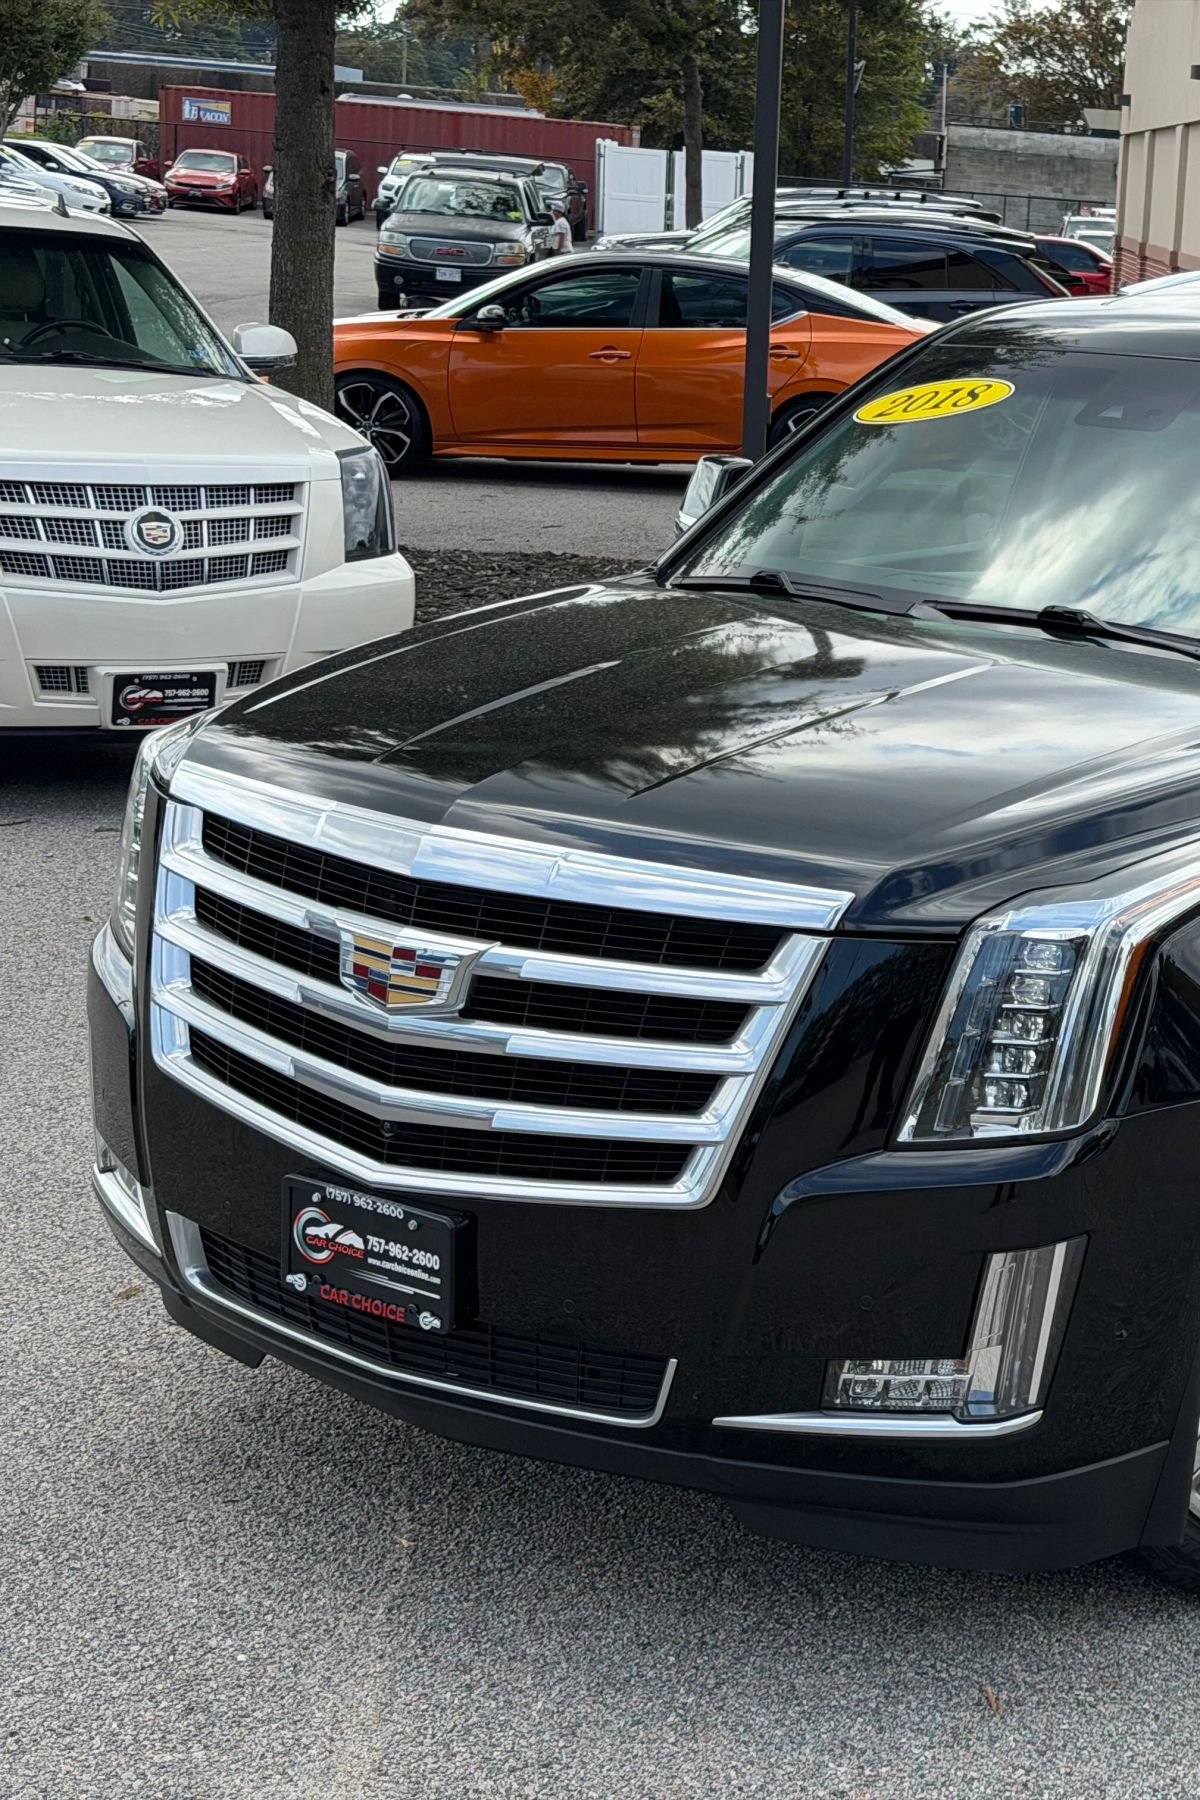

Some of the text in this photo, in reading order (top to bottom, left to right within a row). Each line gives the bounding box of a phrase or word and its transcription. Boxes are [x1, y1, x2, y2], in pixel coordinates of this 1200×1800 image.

[872, 384, 993, 418] 2018
[326, 1186, 405, 1220] (757) 962-2600
[305, 1235, 366, 1260] CAR CHOICE
[366, 1235, 441, 1270] 757-962-2600
[367, 1257, 441, 1285] www.carchoiceonline.com
[320, 1285, 406, 1322] CAR CHOICE
